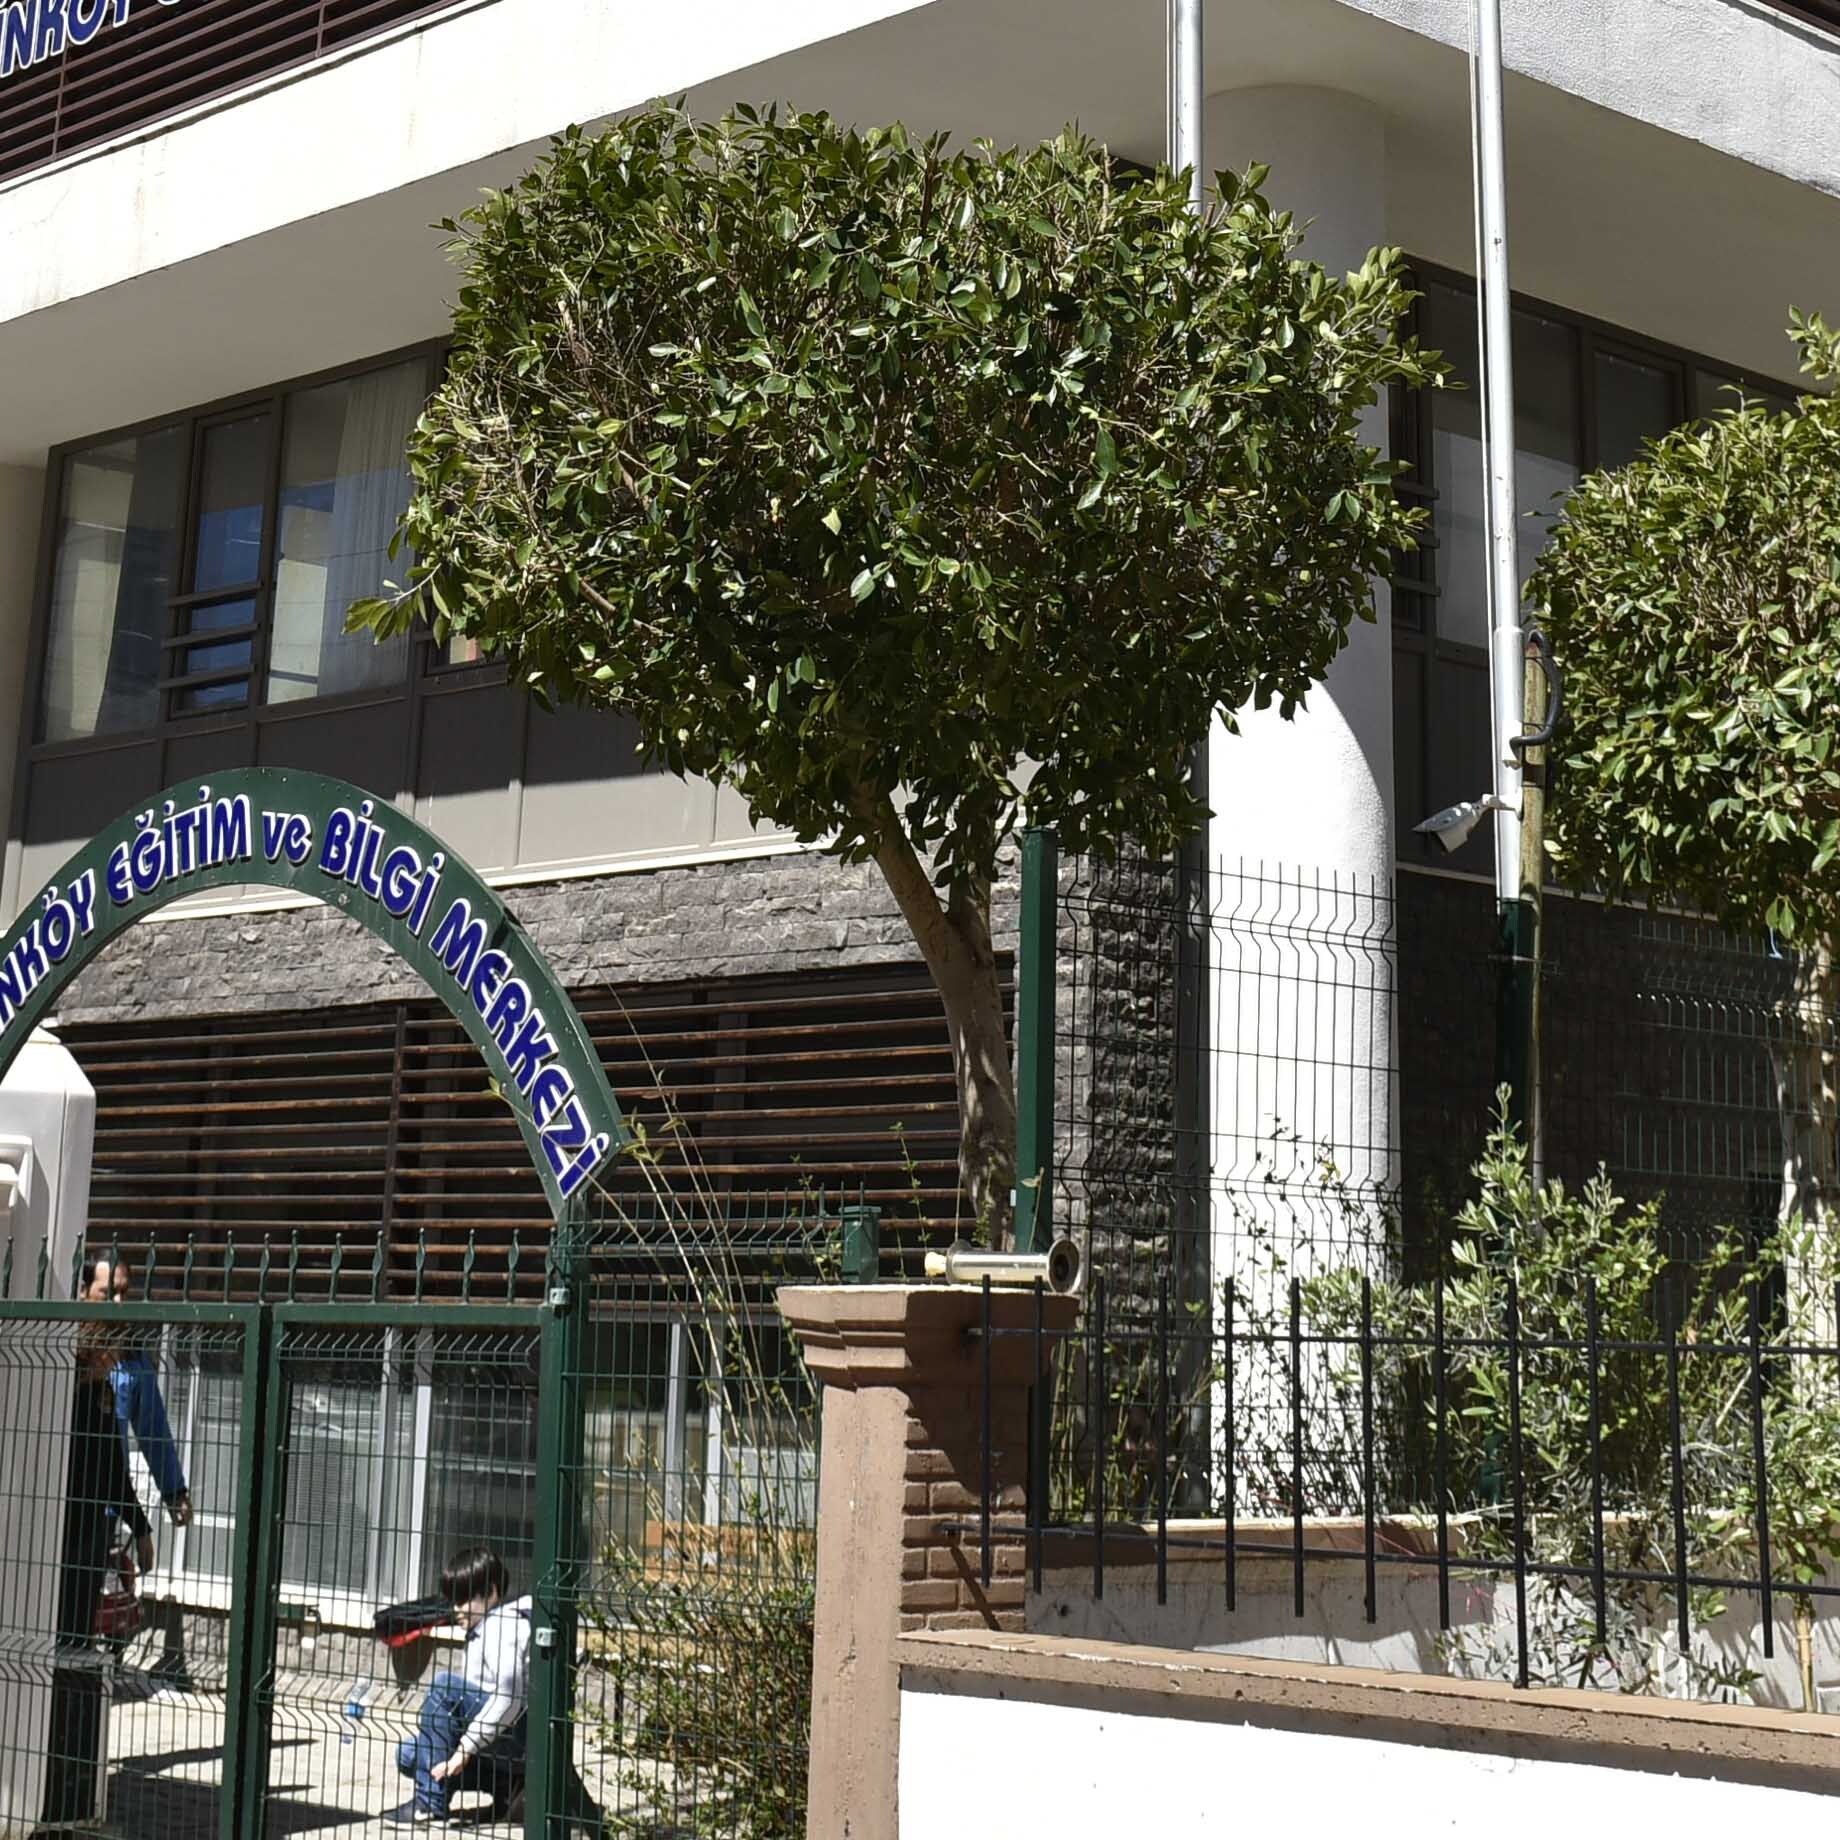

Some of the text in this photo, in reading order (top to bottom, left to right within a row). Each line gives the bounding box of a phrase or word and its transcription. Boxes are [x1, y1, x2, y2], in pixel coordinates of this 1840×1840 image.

[105, 785, 253, 905] EĞİTİM
[260, 809, 313, 866] ve
[319, 798, 446, 937] BİLGİ
[431, 896, 613, 1201] MERKEZİ
